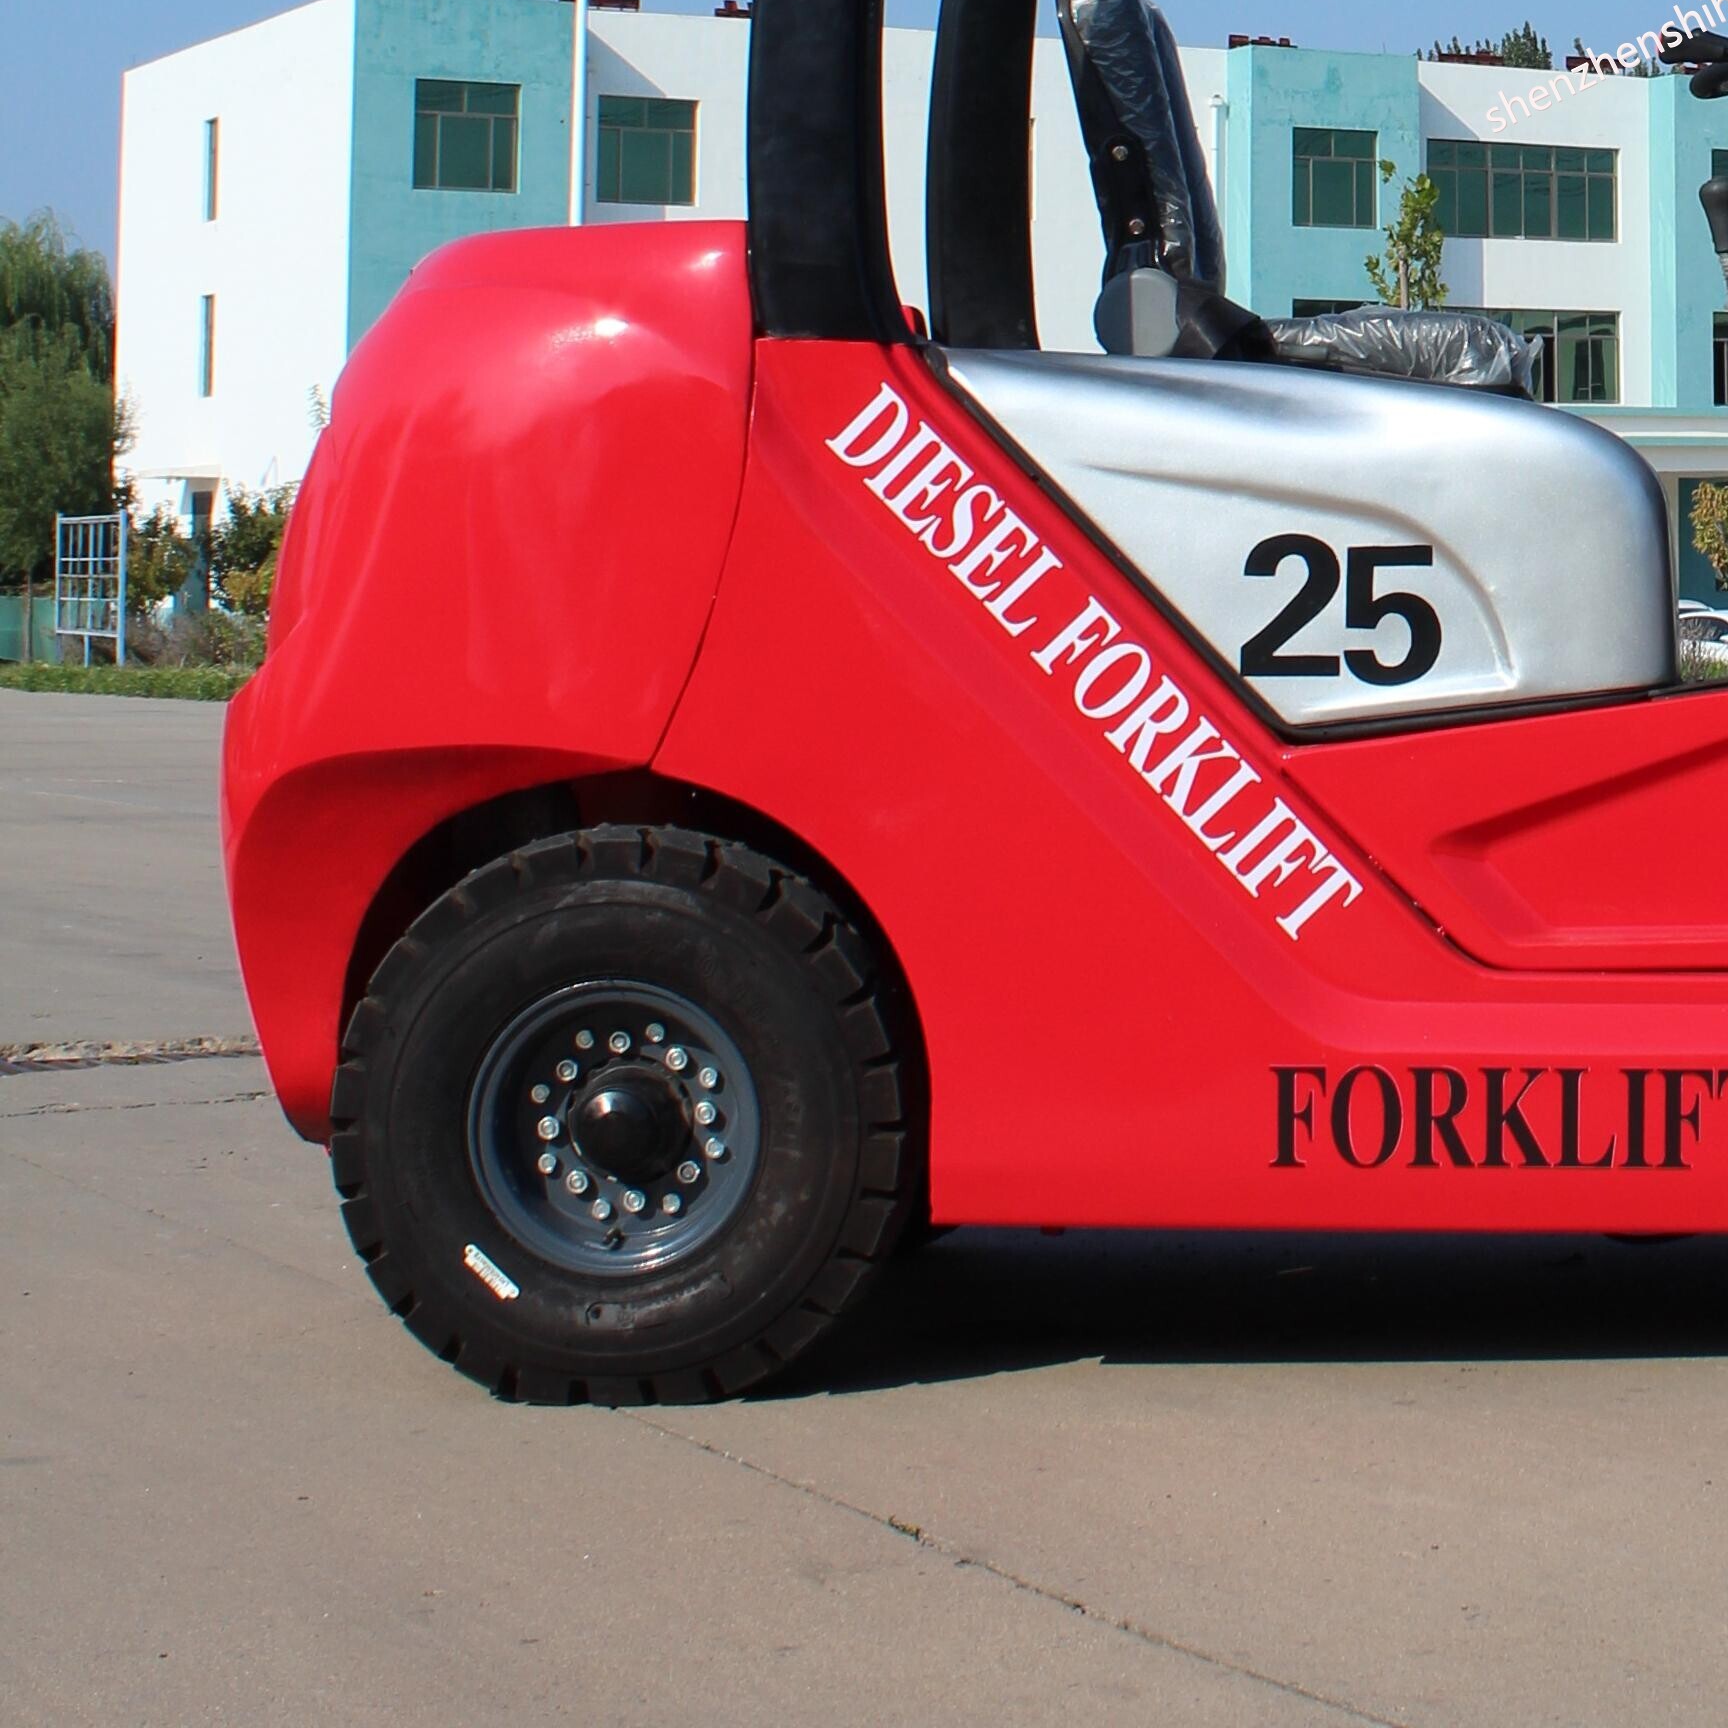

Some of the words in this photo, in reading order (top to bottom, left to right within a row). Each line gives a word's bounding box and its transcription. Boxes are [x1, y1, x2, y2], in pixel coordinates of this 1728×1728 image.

[825, 381, 1063, 637] DIESEL
[1031, 595, 1363, 940] FORKLIFT
[1240, 533, 1442, 686] 25
